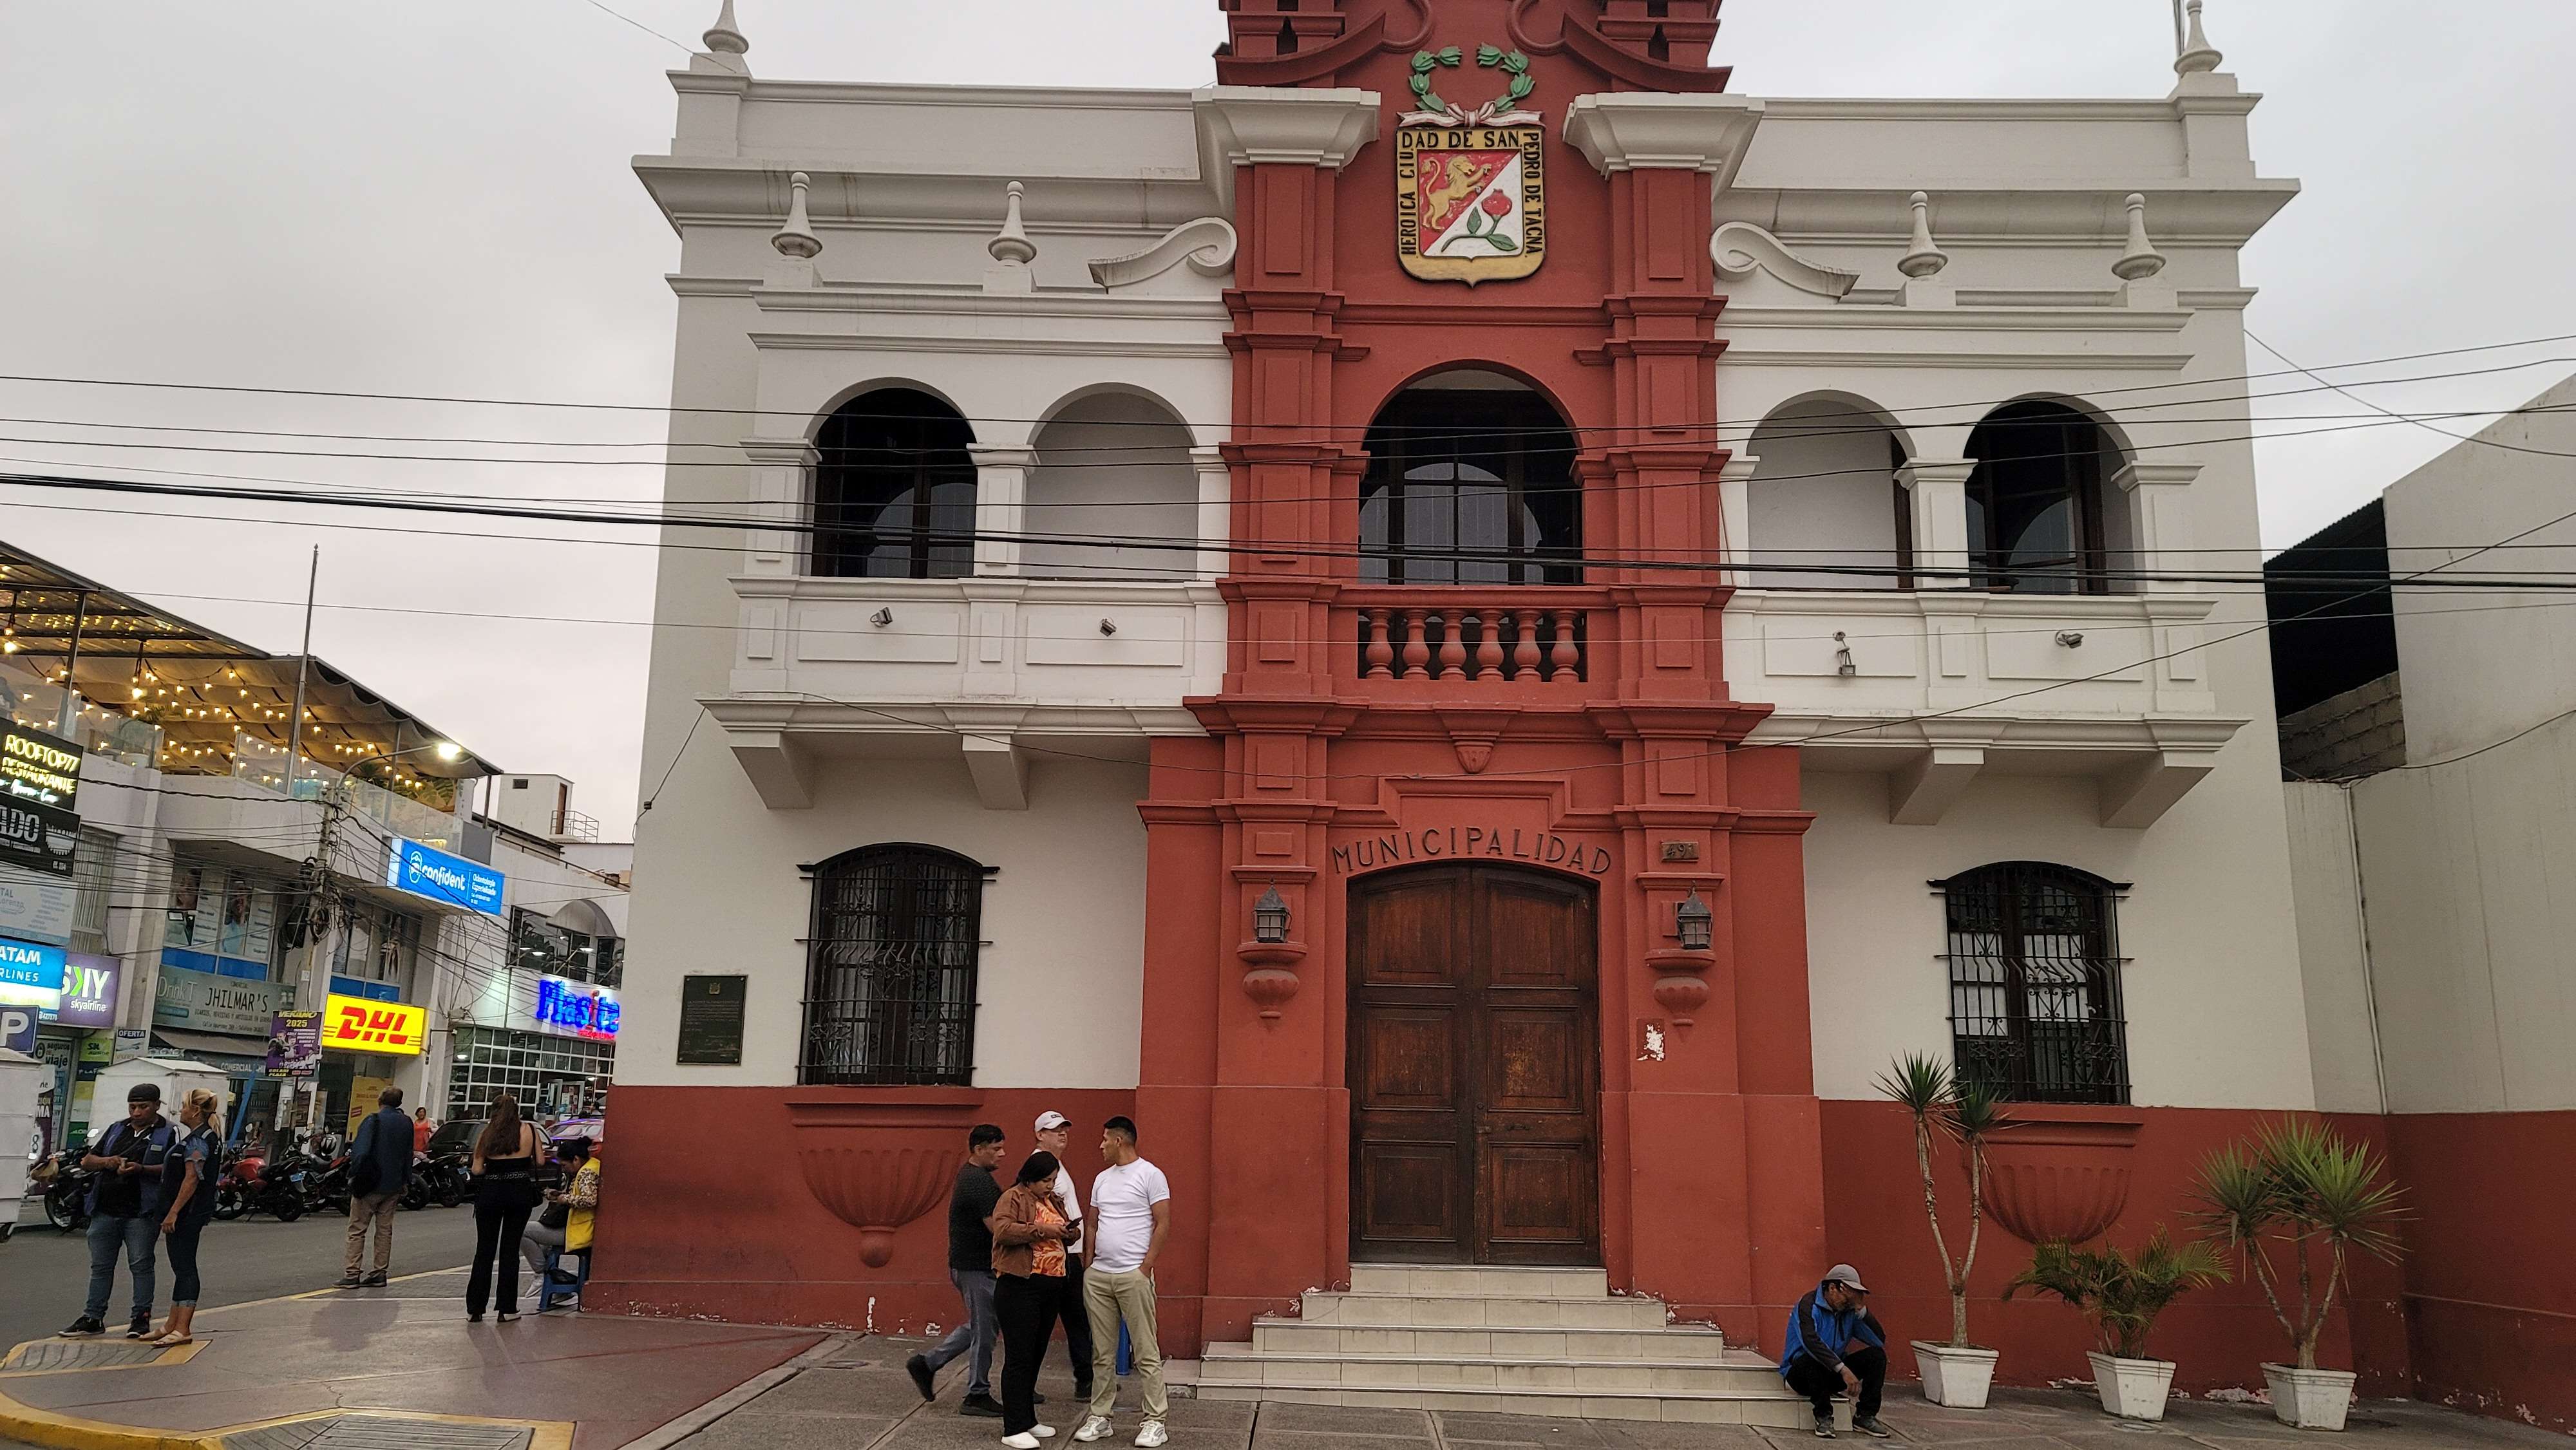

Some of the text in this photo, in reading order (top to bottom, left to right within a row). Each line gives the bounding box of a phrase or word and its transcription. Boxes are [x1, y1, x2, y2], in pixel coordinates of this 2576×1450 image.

[1523, 132, 1540, 179] PEDRO
[1400, 191, 1417, 255] HEROICA
[1448, 131, 1473, 147] DE
[1524, 185, 1541, 203] DE
[1332, 826, 1611, 874] MUNICIPALIDAD
[421, 865, 466, 891] confident
[70, 999, 107, 1012] skyairline
[205, 987, 268, 1013] JHILMAR'S
[1, 1012, 29, 1047] P
[285, 1019, 308, 1028] 2025
[336, 1006, 409, 1045] DHL
[46, 1042, 70, 1051] seguros
[46, 1055, 68, 1068] viaje
[221, 1062, 252, 1072] COMERCIAL
